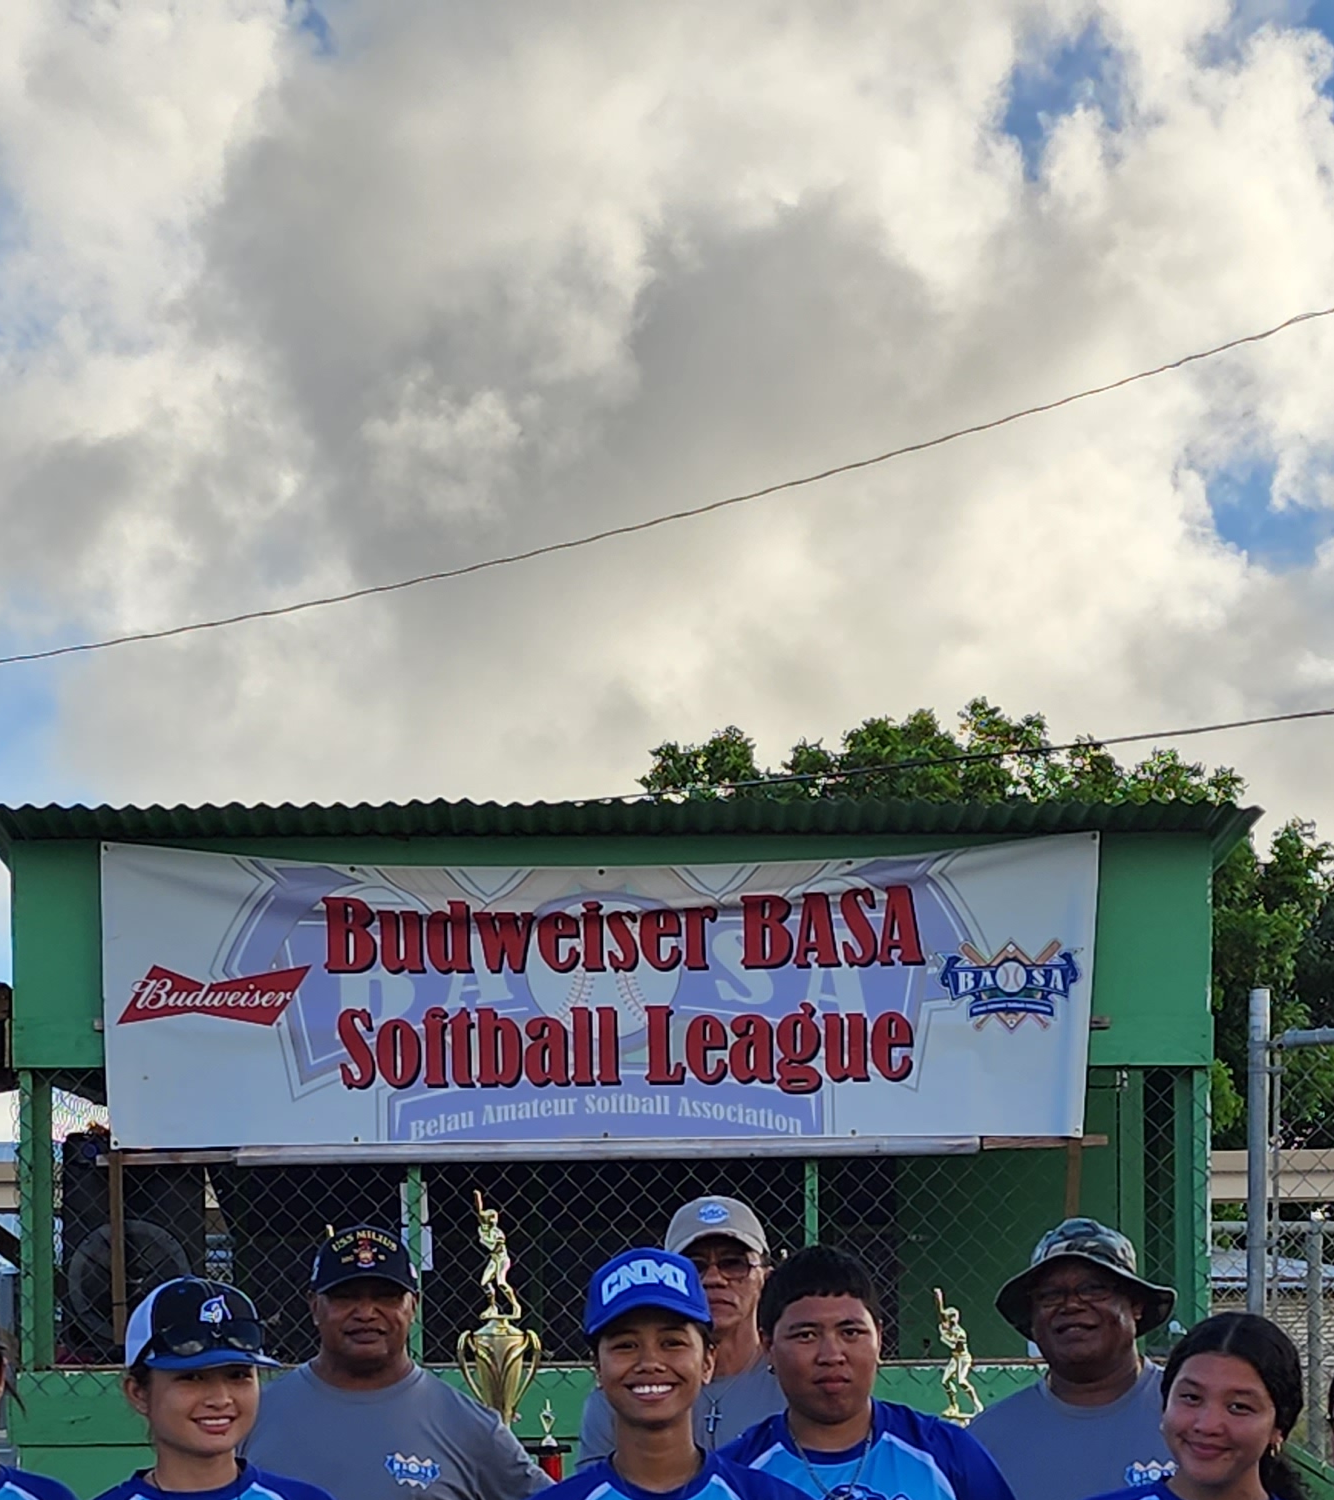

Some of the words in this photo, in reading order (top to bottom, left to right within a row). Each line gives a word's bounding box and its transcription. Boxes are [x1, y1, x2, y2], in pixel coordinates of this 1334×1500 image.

[322, 894, 717, 974] Budweiser
[740, 884, 925, 969] BASA
[131, 977, 295, 1011] Budweiser
[337, 1006, 620, 1090] Softball
[645, 1001, 914, 1096] League
[408, 1110, 475, 1141] Belau
[482, 1094, 576, 1125] Amateur
[585, 1093, 669, 1116] Softball
[677, 1096, 803, 1136] Association
[601, 1259, 690, 1306] CNMI
